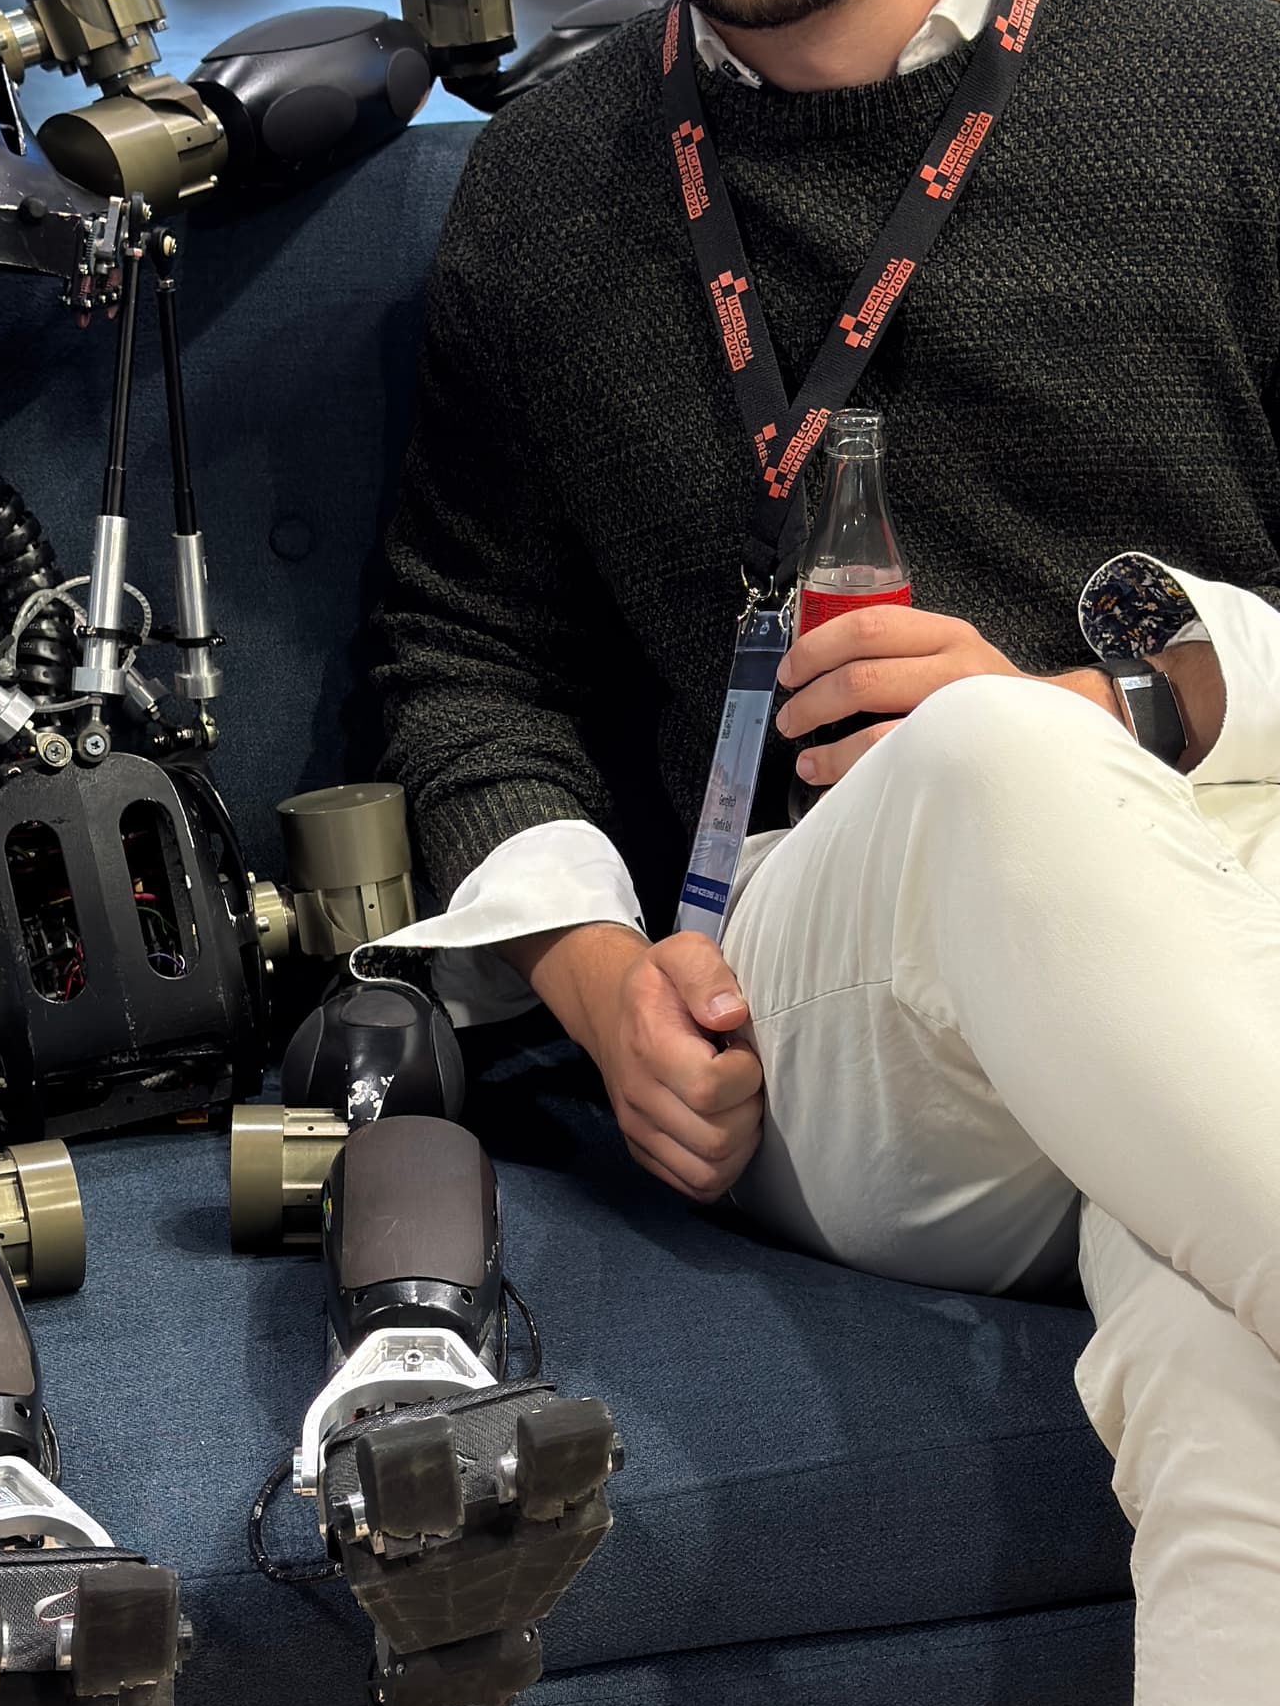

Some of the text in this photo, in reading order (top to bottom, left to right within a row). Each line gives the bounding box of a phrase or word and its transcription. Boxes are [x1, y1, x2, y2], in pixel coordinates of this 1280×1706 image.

[1013, 1, 1036, 53] BREMEN
[671, 131, 701, 218] BREMEN 2026
[941, 114, 991, 200] BREMEN 2026
[710, 280, 744, 369] BREMEN 2026
[860, 260, 913, 349] BREMEN 2026
[780, 442, 811, 499] BREMEN
